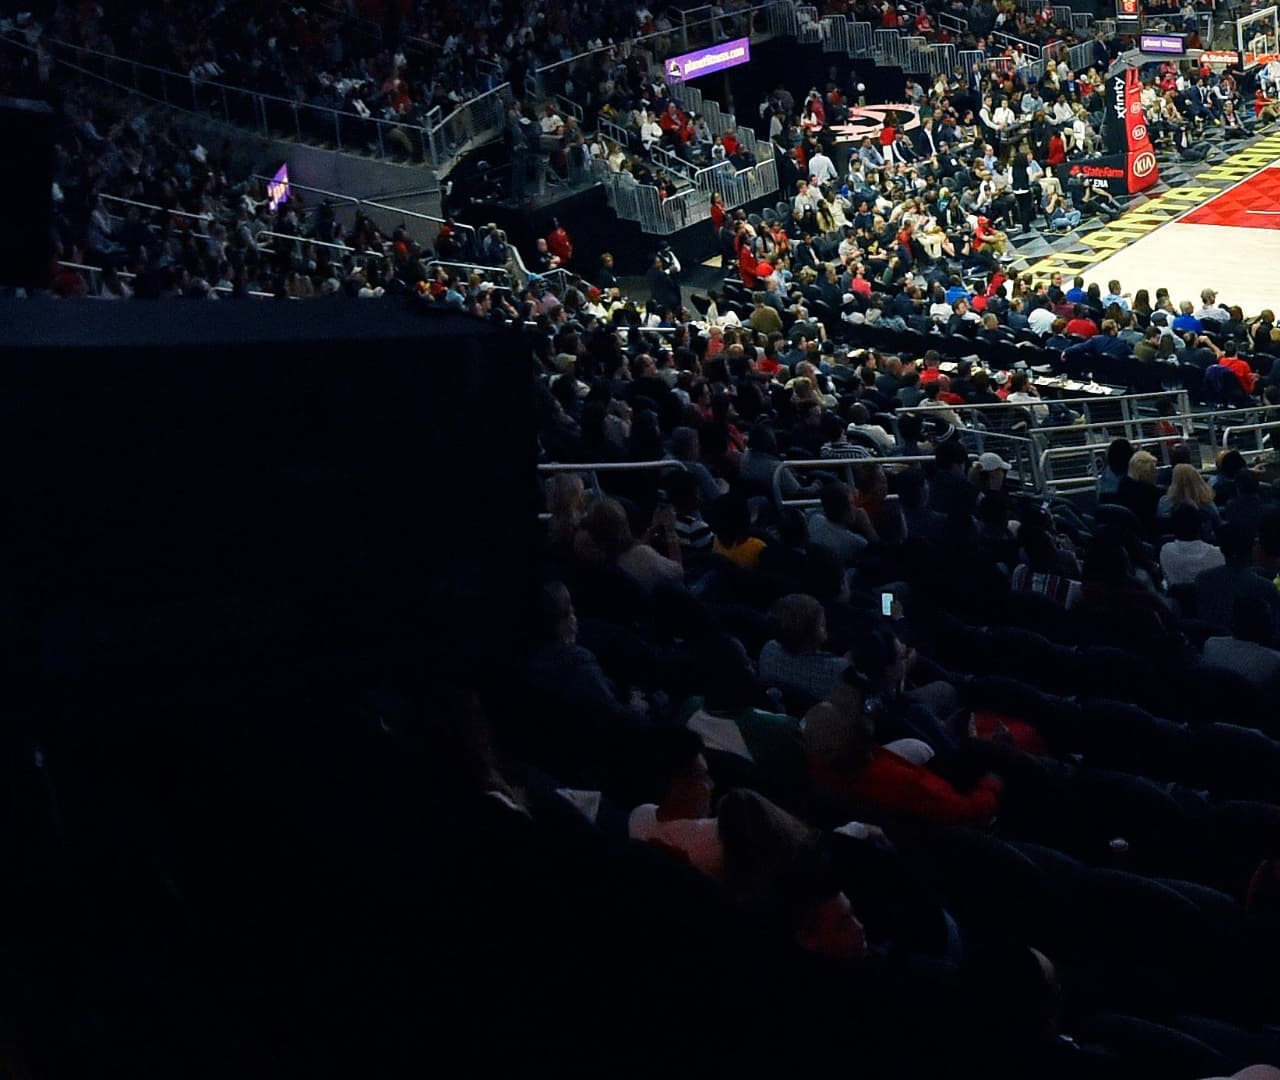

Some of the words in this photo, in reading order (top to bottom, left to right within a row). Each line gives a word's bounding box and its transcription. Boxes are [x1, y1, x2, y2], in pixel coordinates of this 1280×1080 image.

[1114, 77, 1127, 119] xfinity
[1083, 165, 1105, 178] State
[1105, 166, 1124, 178] Farm
[1135, 156, 1153, 173] KIA
[1017, 186, 1222, 288] TLANTA
